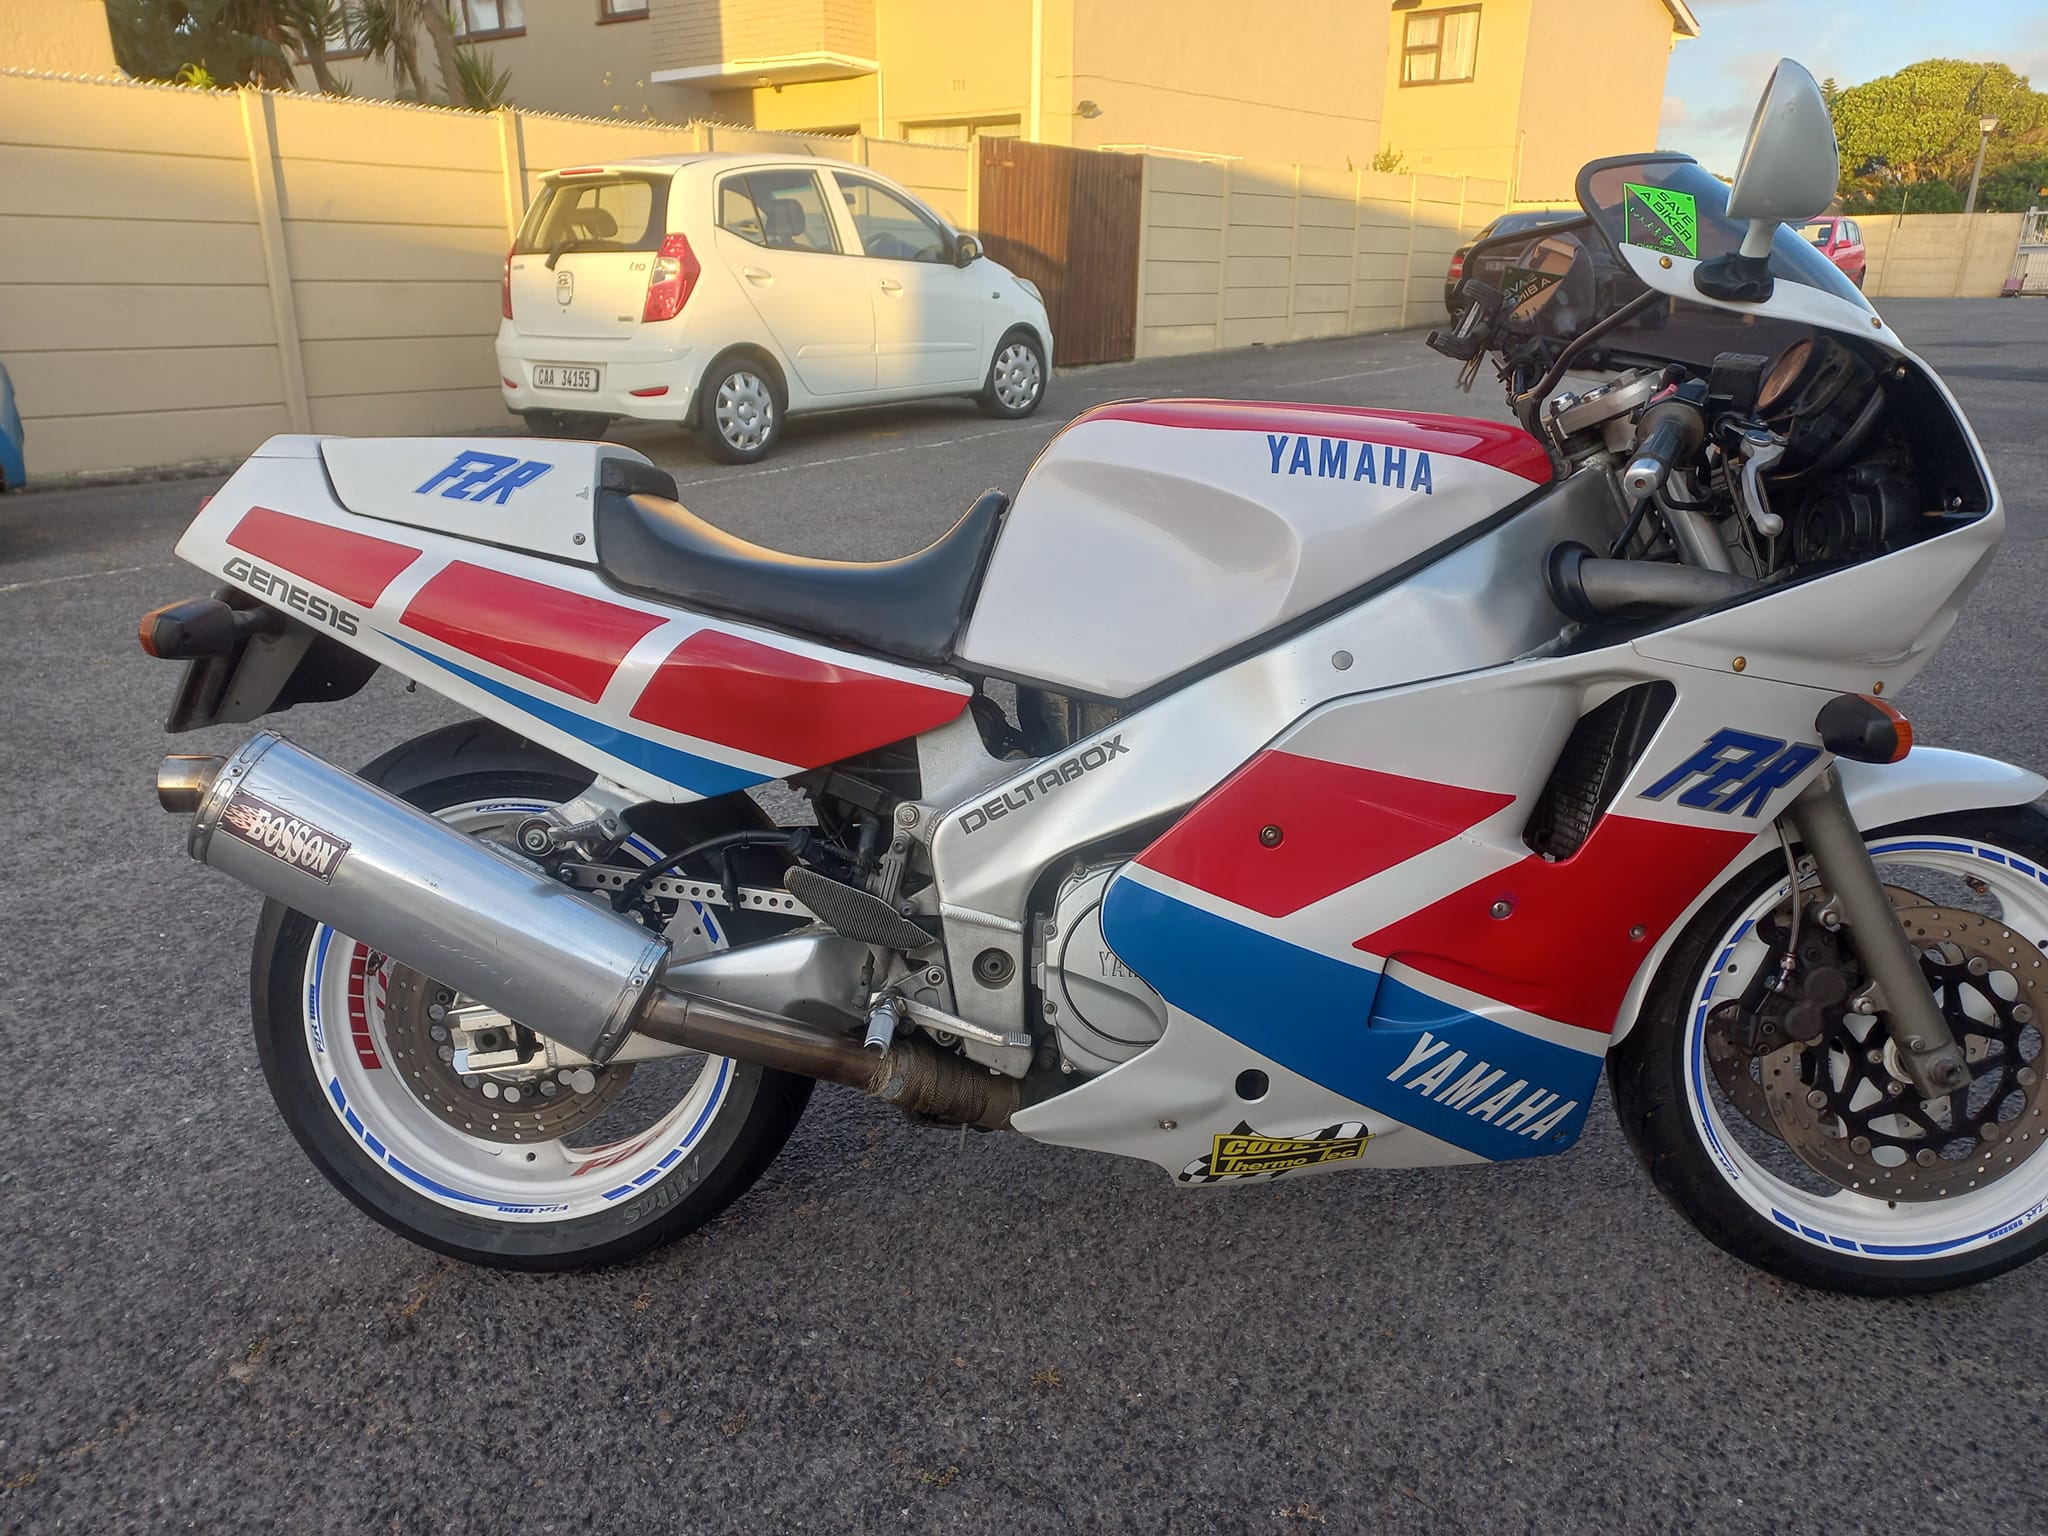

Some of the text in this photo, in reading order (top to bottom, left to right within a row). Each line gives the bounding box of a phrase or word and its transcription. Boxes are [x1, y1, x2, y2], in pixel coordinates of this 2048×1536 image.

[1640, 192, 1692, 241] A BIKER
[1657, 191, 1693, 226] SAVE
[538, 369, 590, 388] CAA 34155
[412, 449, 555, 506] FZR
[1266, 434, 1433, 495] YAMAHA
[222, 556, 360, 637] GENESIS
[958, 734, 1131, 835] DELTABOX
[1635, 726, 1825, 819] FZR
[245, 807, 340, 874] BOSSON
[1386, 1031, 1578, 1141] YAMAHA
[1219, 1146, 1356, 1172] Thermo Tec
